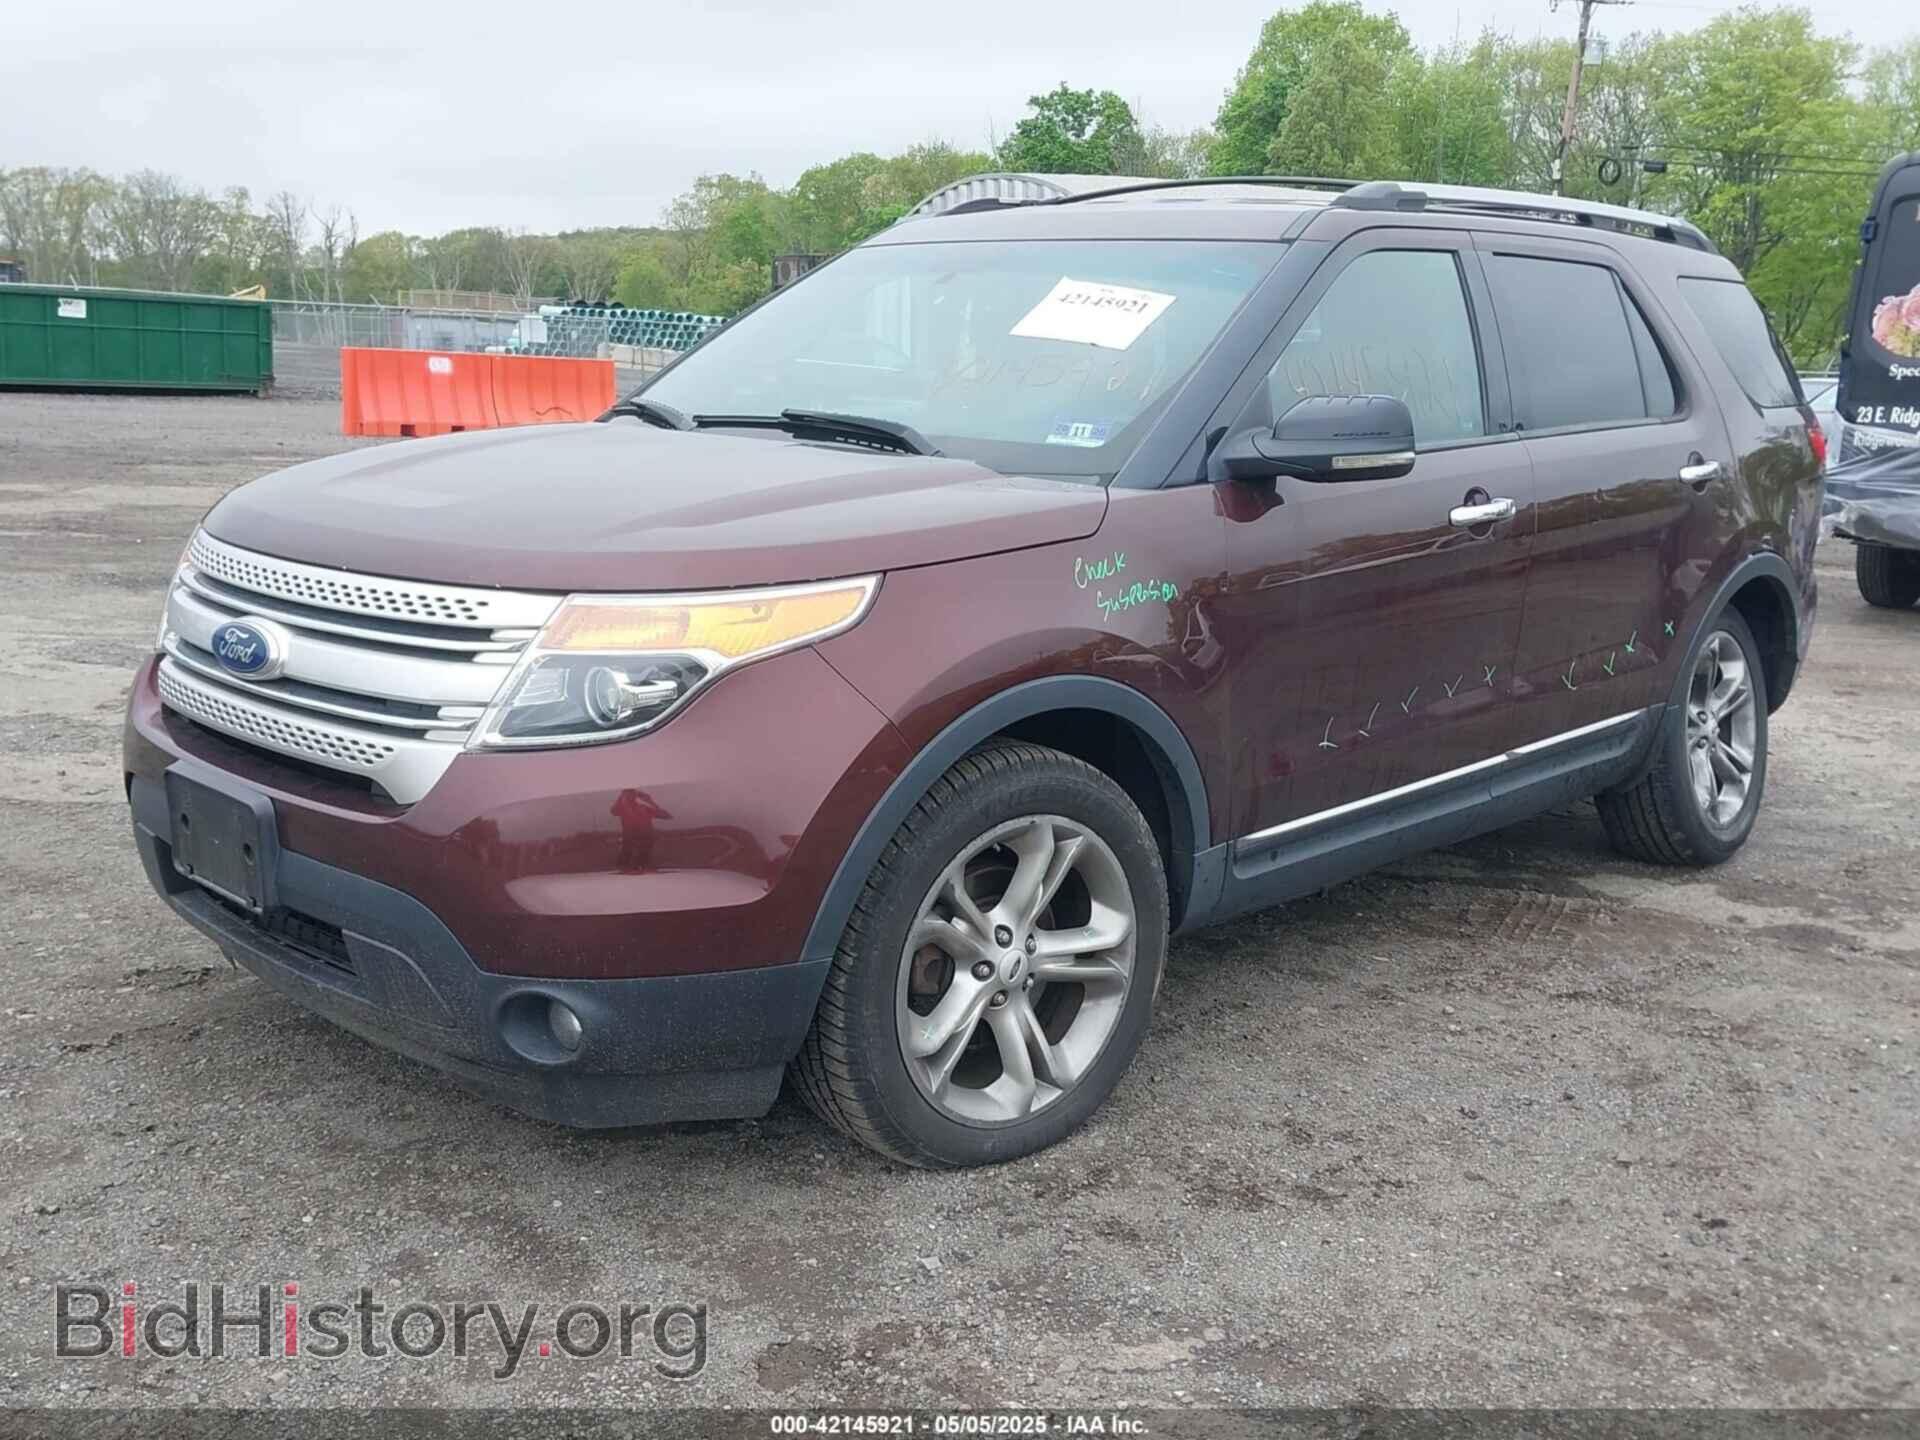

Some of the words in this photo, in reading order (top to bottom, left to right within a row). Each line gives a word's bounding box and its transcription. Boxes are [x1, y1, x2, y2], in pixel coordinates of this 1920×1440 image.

[1856, 406, 1873, 423] 23
[1875, 406, 1886, 423] E.
[219, 627, 257, 663] Ford
